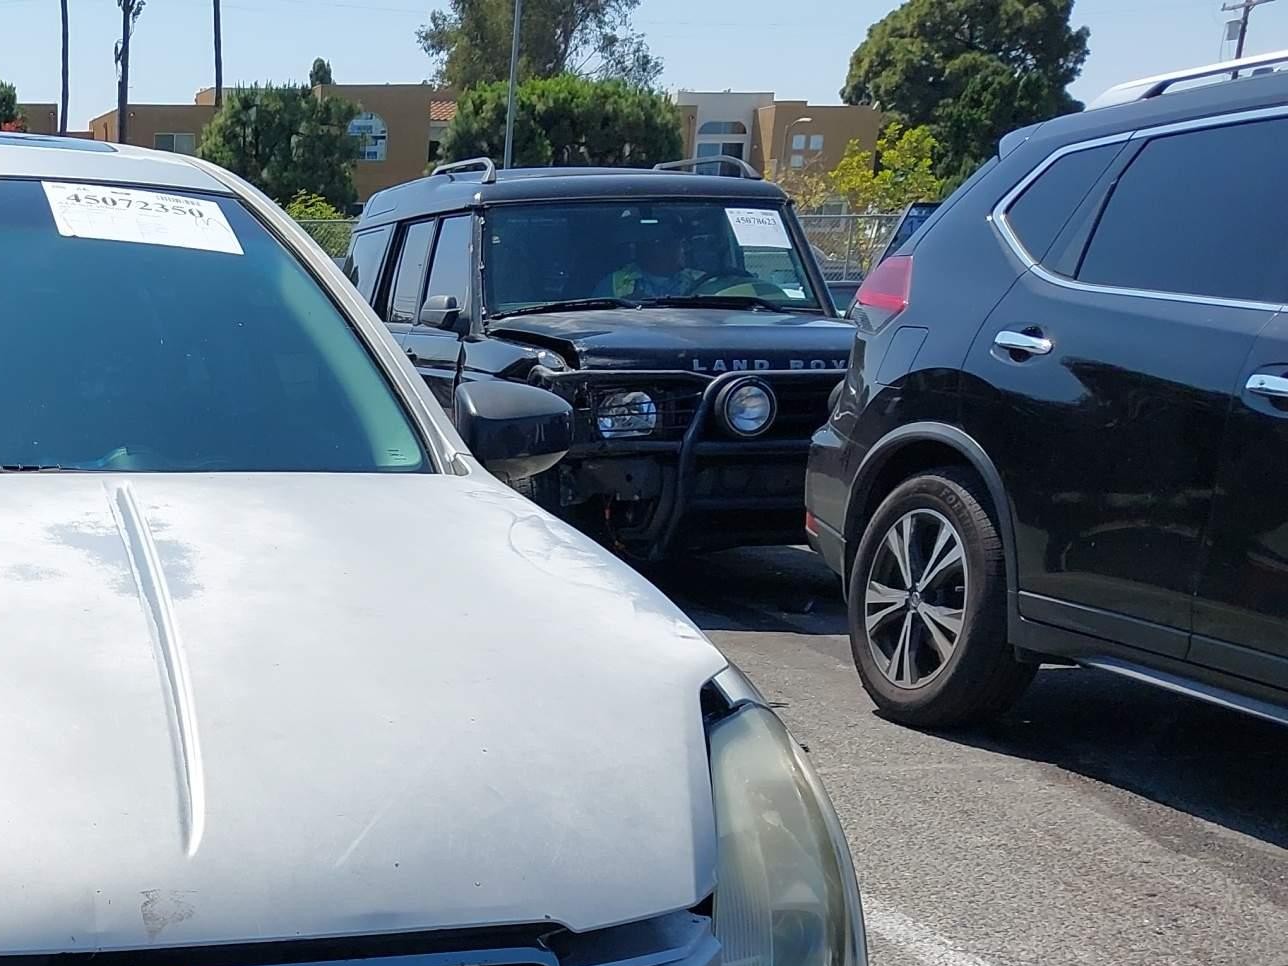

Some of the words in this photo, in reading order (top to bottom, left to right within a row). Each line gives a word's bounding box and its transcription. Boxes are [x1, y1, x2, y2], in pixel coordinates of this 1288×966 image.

[66, 192, 205, 219] 45072350
[692, 358, 770, 371] LAND
[789, 359, 847, 370] ROV
